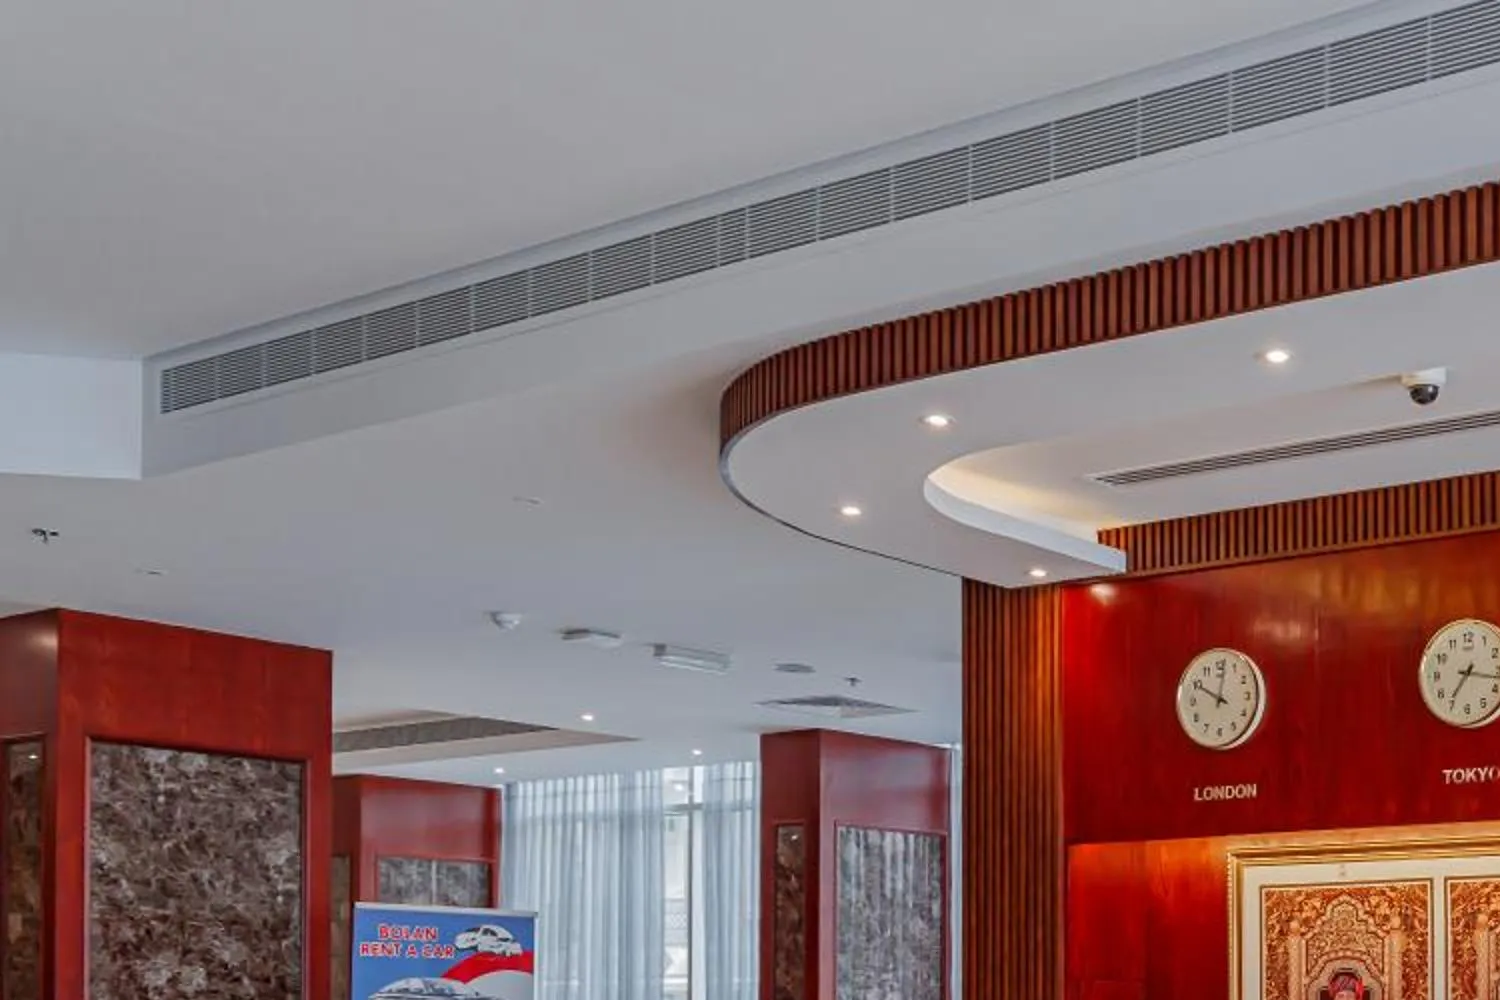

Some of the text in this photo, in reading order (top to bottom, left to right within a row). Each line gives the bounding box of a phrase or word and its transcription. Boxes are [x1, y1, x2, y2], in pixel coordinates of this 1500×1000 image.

[1193, 783, 1258, 801] LONDON
[378, 924, 438, 941] BOLAN
[360, 942, 455, 958] RENT A CAR
